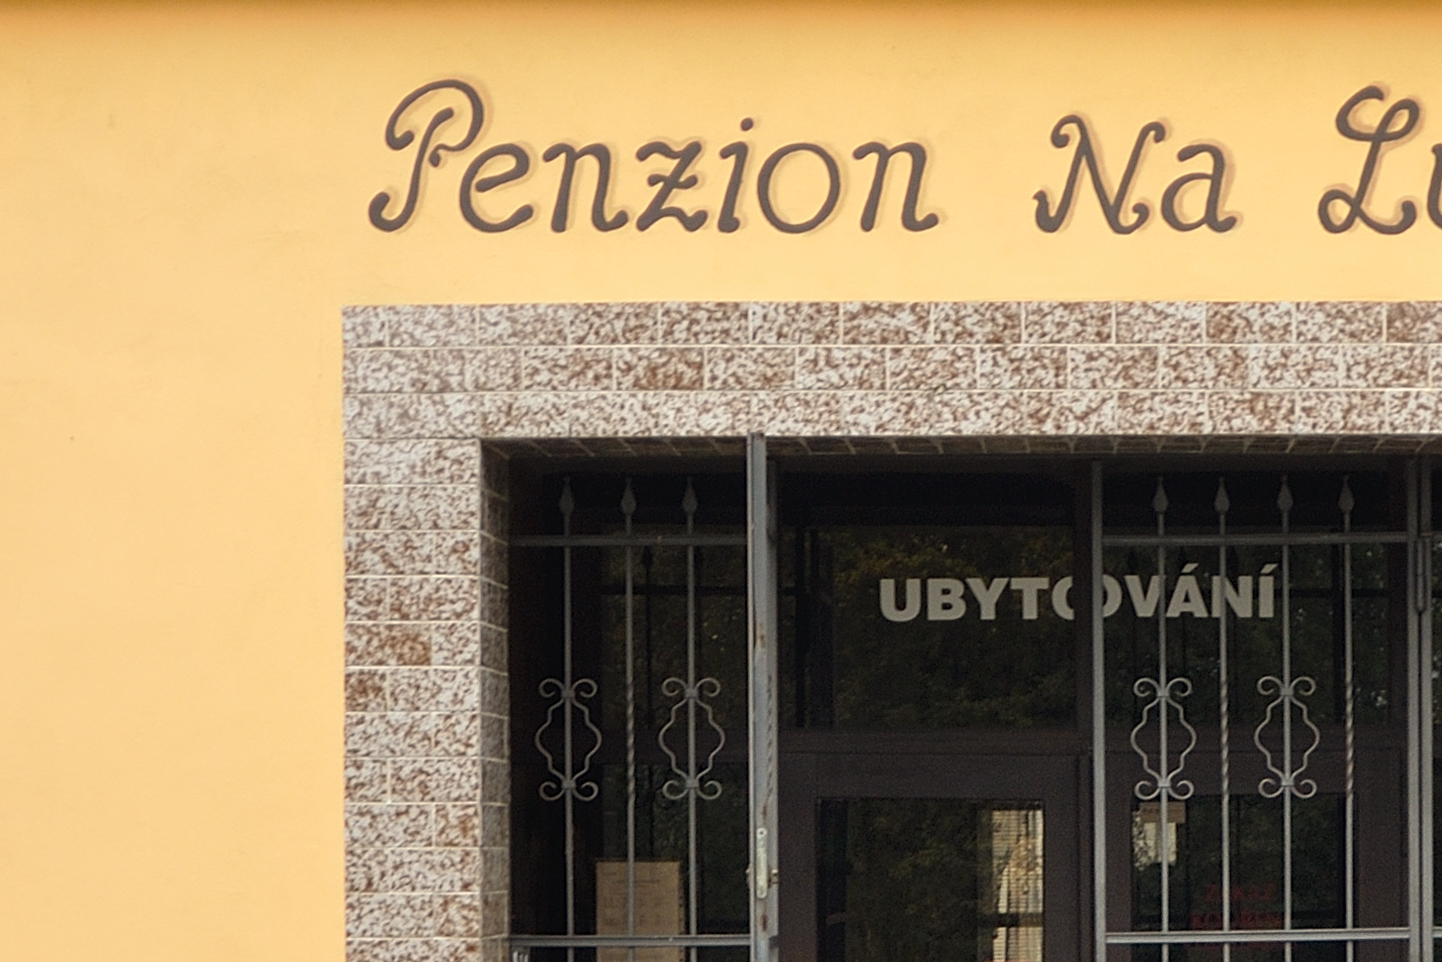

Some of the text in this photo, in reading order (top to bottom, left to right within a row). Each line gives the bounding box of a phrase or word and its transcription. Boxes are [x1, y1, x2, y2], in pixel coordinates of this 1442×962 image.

[369, 80, 938, 233] Penzion
[1034, 115, 1237, 234] Na
[879, 563, 1278, 622] UBYTOVÁNÍ
